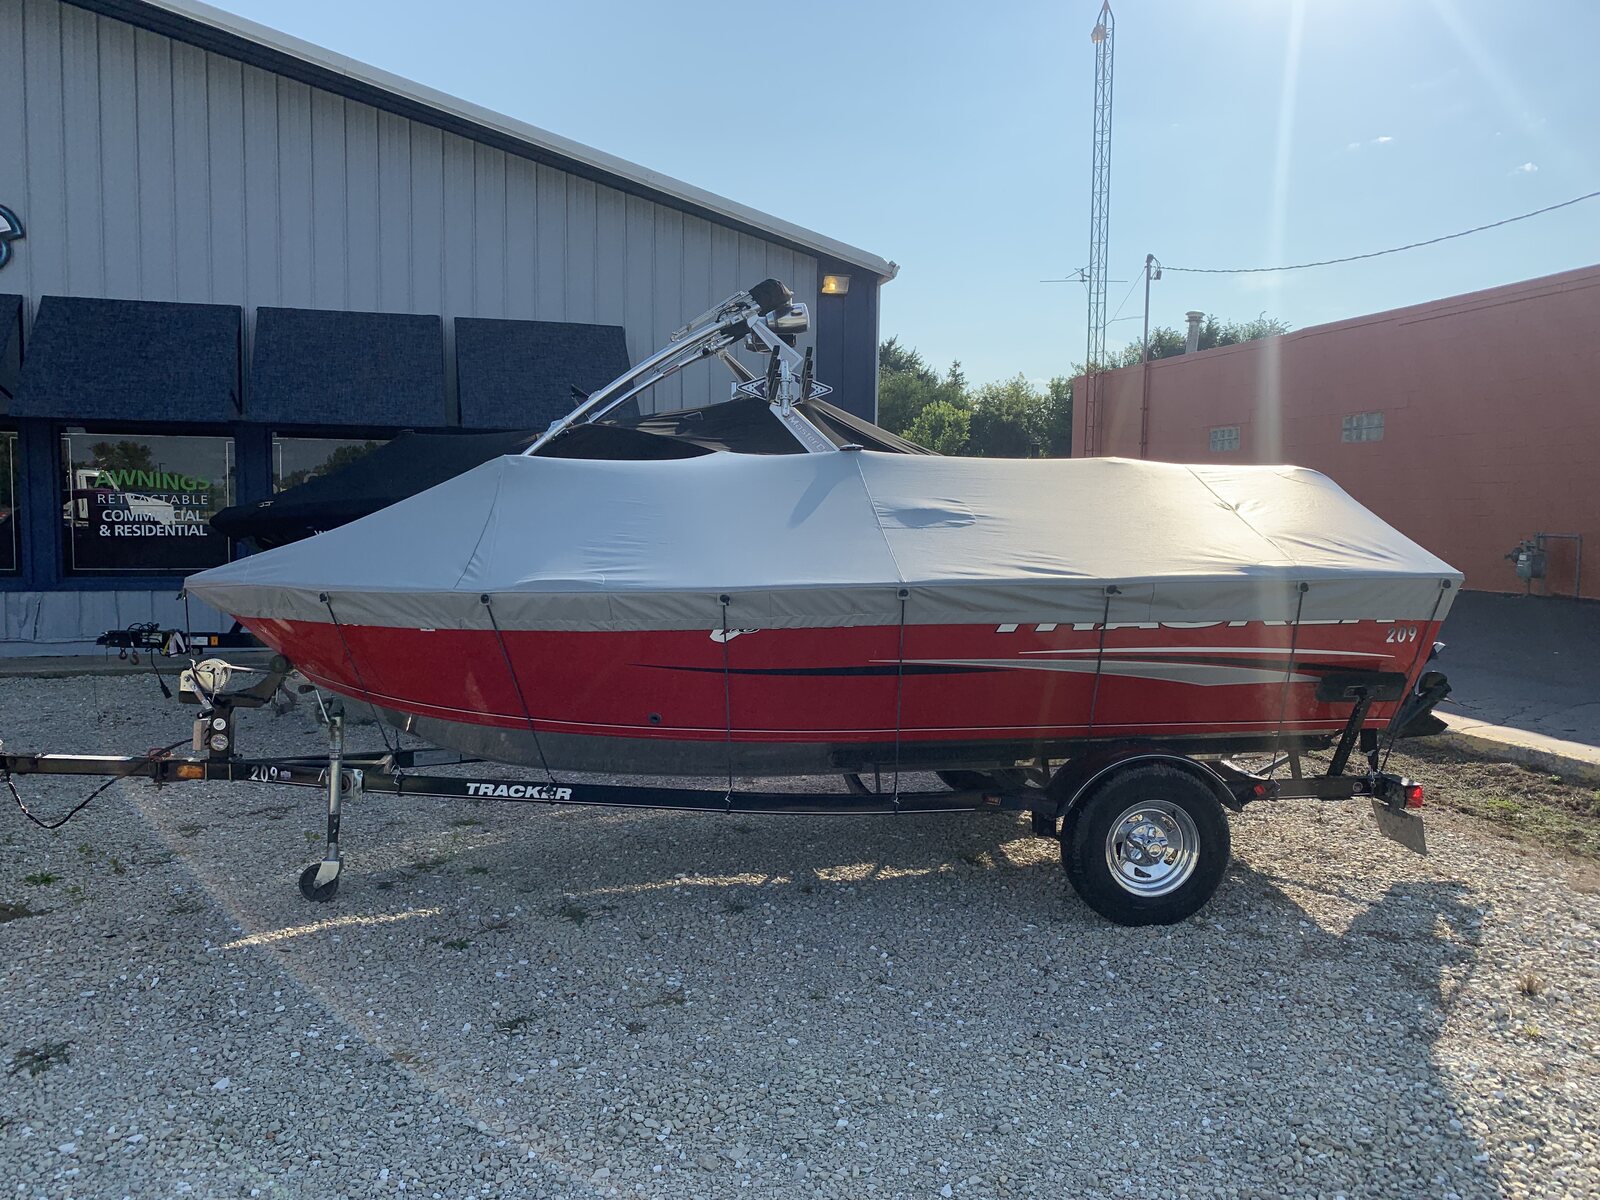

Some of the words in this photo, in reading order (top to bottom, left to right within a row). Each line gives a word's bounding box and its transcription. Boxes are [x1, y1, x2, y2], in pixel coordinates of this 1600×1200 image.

[94, 469, 210, 491] AWNINGS
[102, 509, 204, 522] COMMCIAL
[99, 524, 111, 537] &
[115, 524, 208, 537] RESIDENTIAL
[1386, 625, 1417, 643] 209
[250, 765, 278, 783] 209
